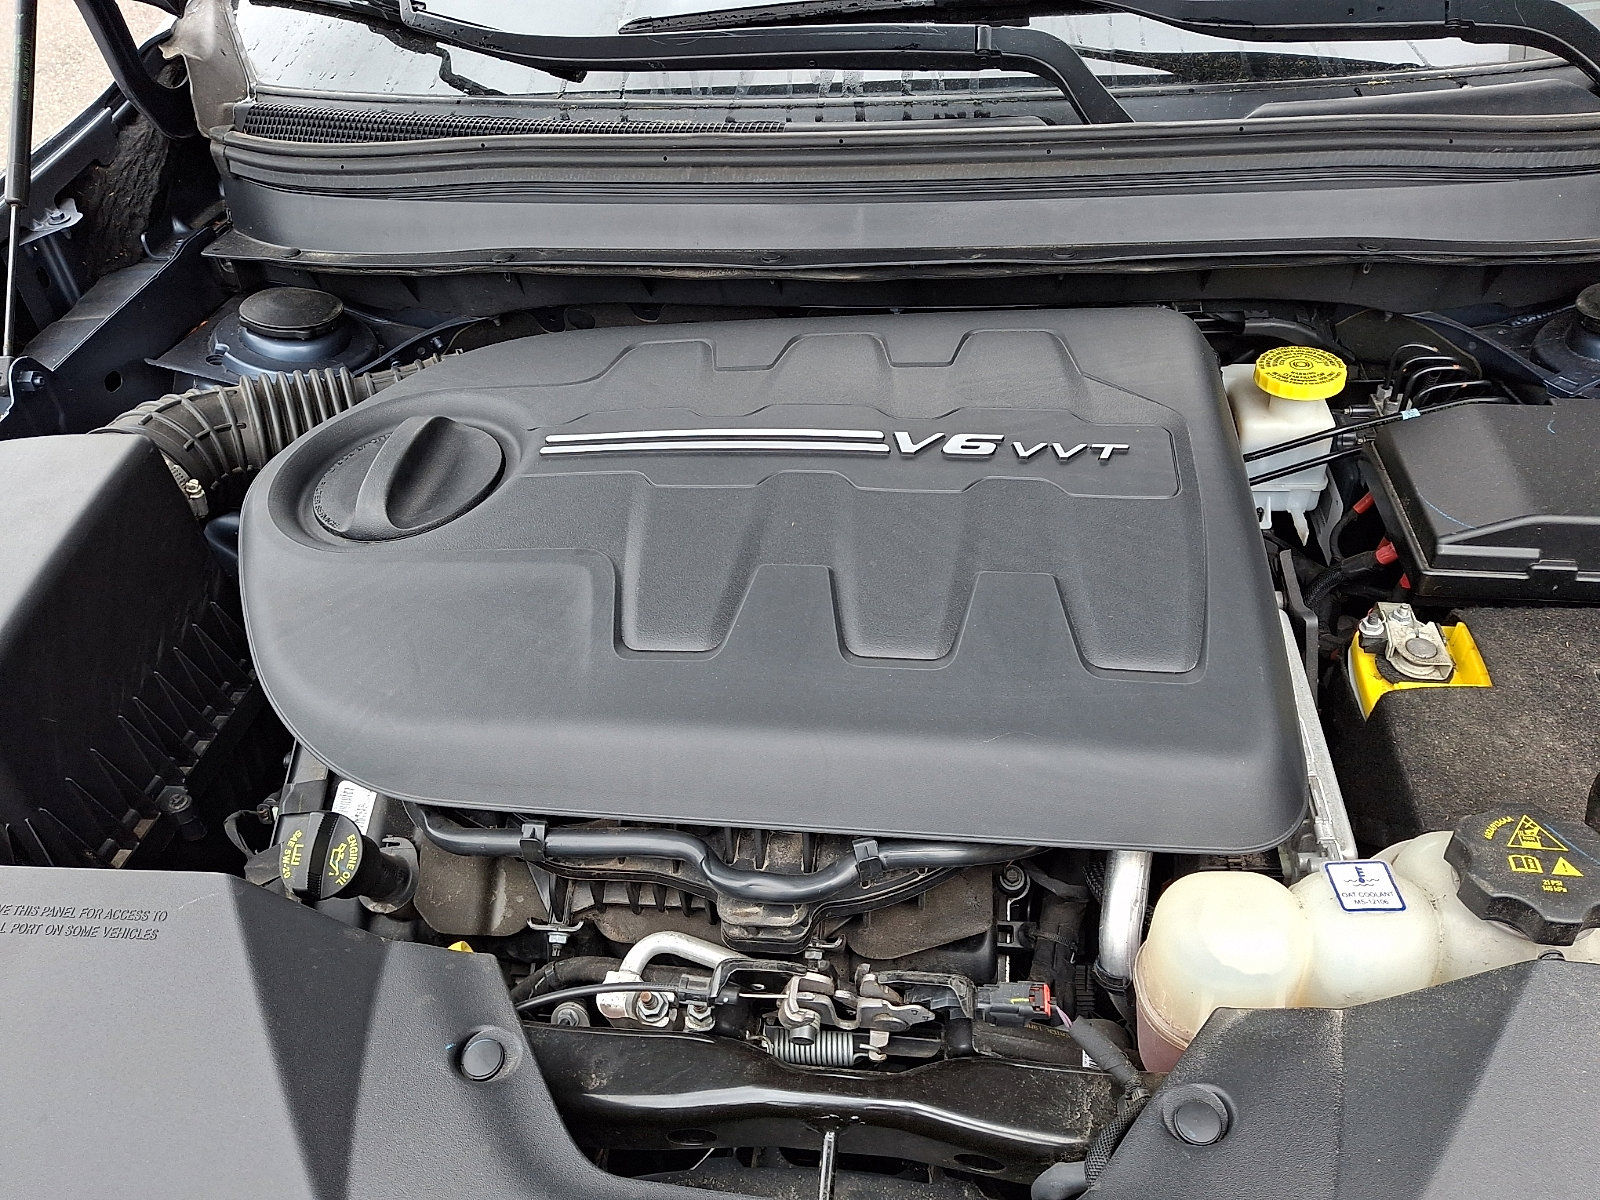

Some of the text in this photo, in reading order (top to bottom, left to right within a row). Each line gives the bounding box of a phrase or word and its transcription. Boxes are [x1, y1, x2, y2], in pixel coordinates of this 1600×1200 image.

[893, 431, 1130, 461] V6 VVT
[282, 829, 303, 879] SAE 5W-20
[335, 833, 359, 886] ENGINE OIL
[13, 904, 40, 917] THIS
[40, 905, 76, 919] PANEL
[78, 907, 104, 920] FOR
[103, 908, 151, 922] ACCESS
[152, 910, 168, 922] TO
[9, 922, 43, 935] PORT
[45, 924, 64, 936] ON
[64, 924, 101, 938] SOME
[103, 926, 160, 940] VEHICLES
